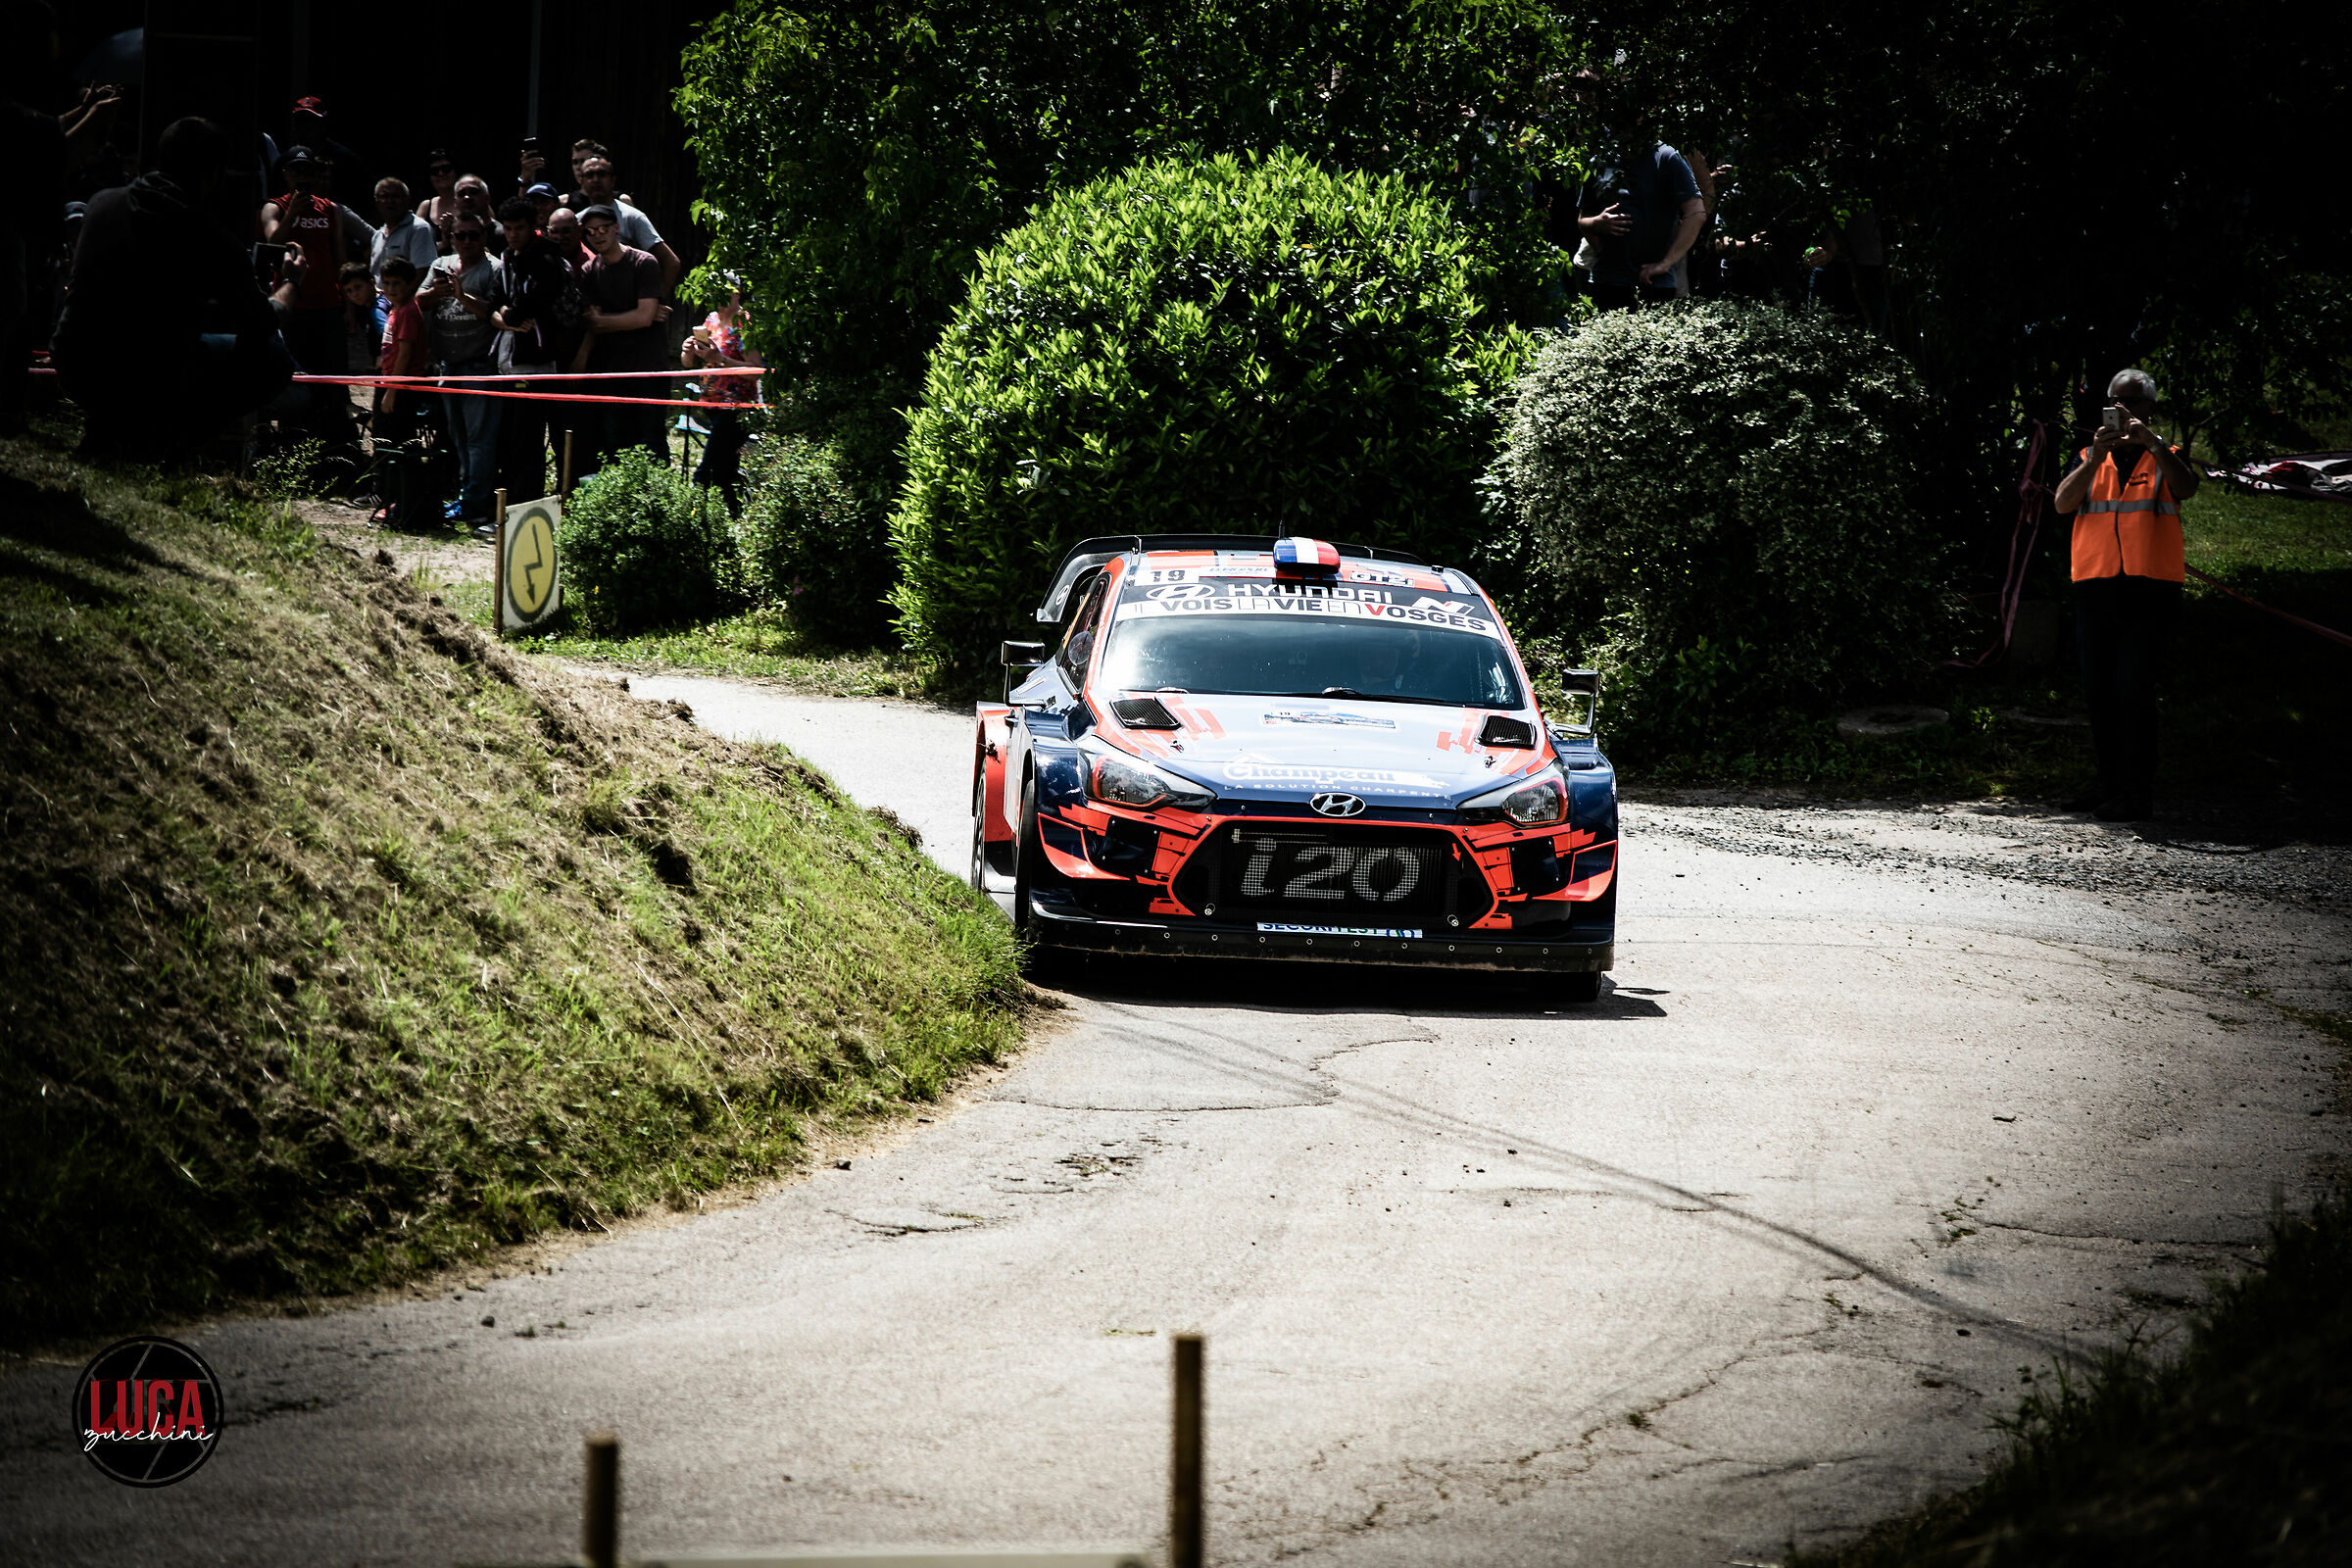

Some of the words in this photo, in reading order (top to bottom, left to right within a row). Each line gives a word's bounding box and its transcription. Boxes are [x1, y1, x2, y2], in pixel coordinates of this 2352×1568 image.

[1151, 569, 1186, 583] 19
[1227, 583, 1393, 605] HYUNDAI
[1159, 598, 1233, 612] VOIS
[1273, 598, 1323, 612] VIE
[1364, 603, 1487, 631] VOSGES
[1225, 763, 1396, 783] Champeau
[1241, 837, 1420, 902] i20
